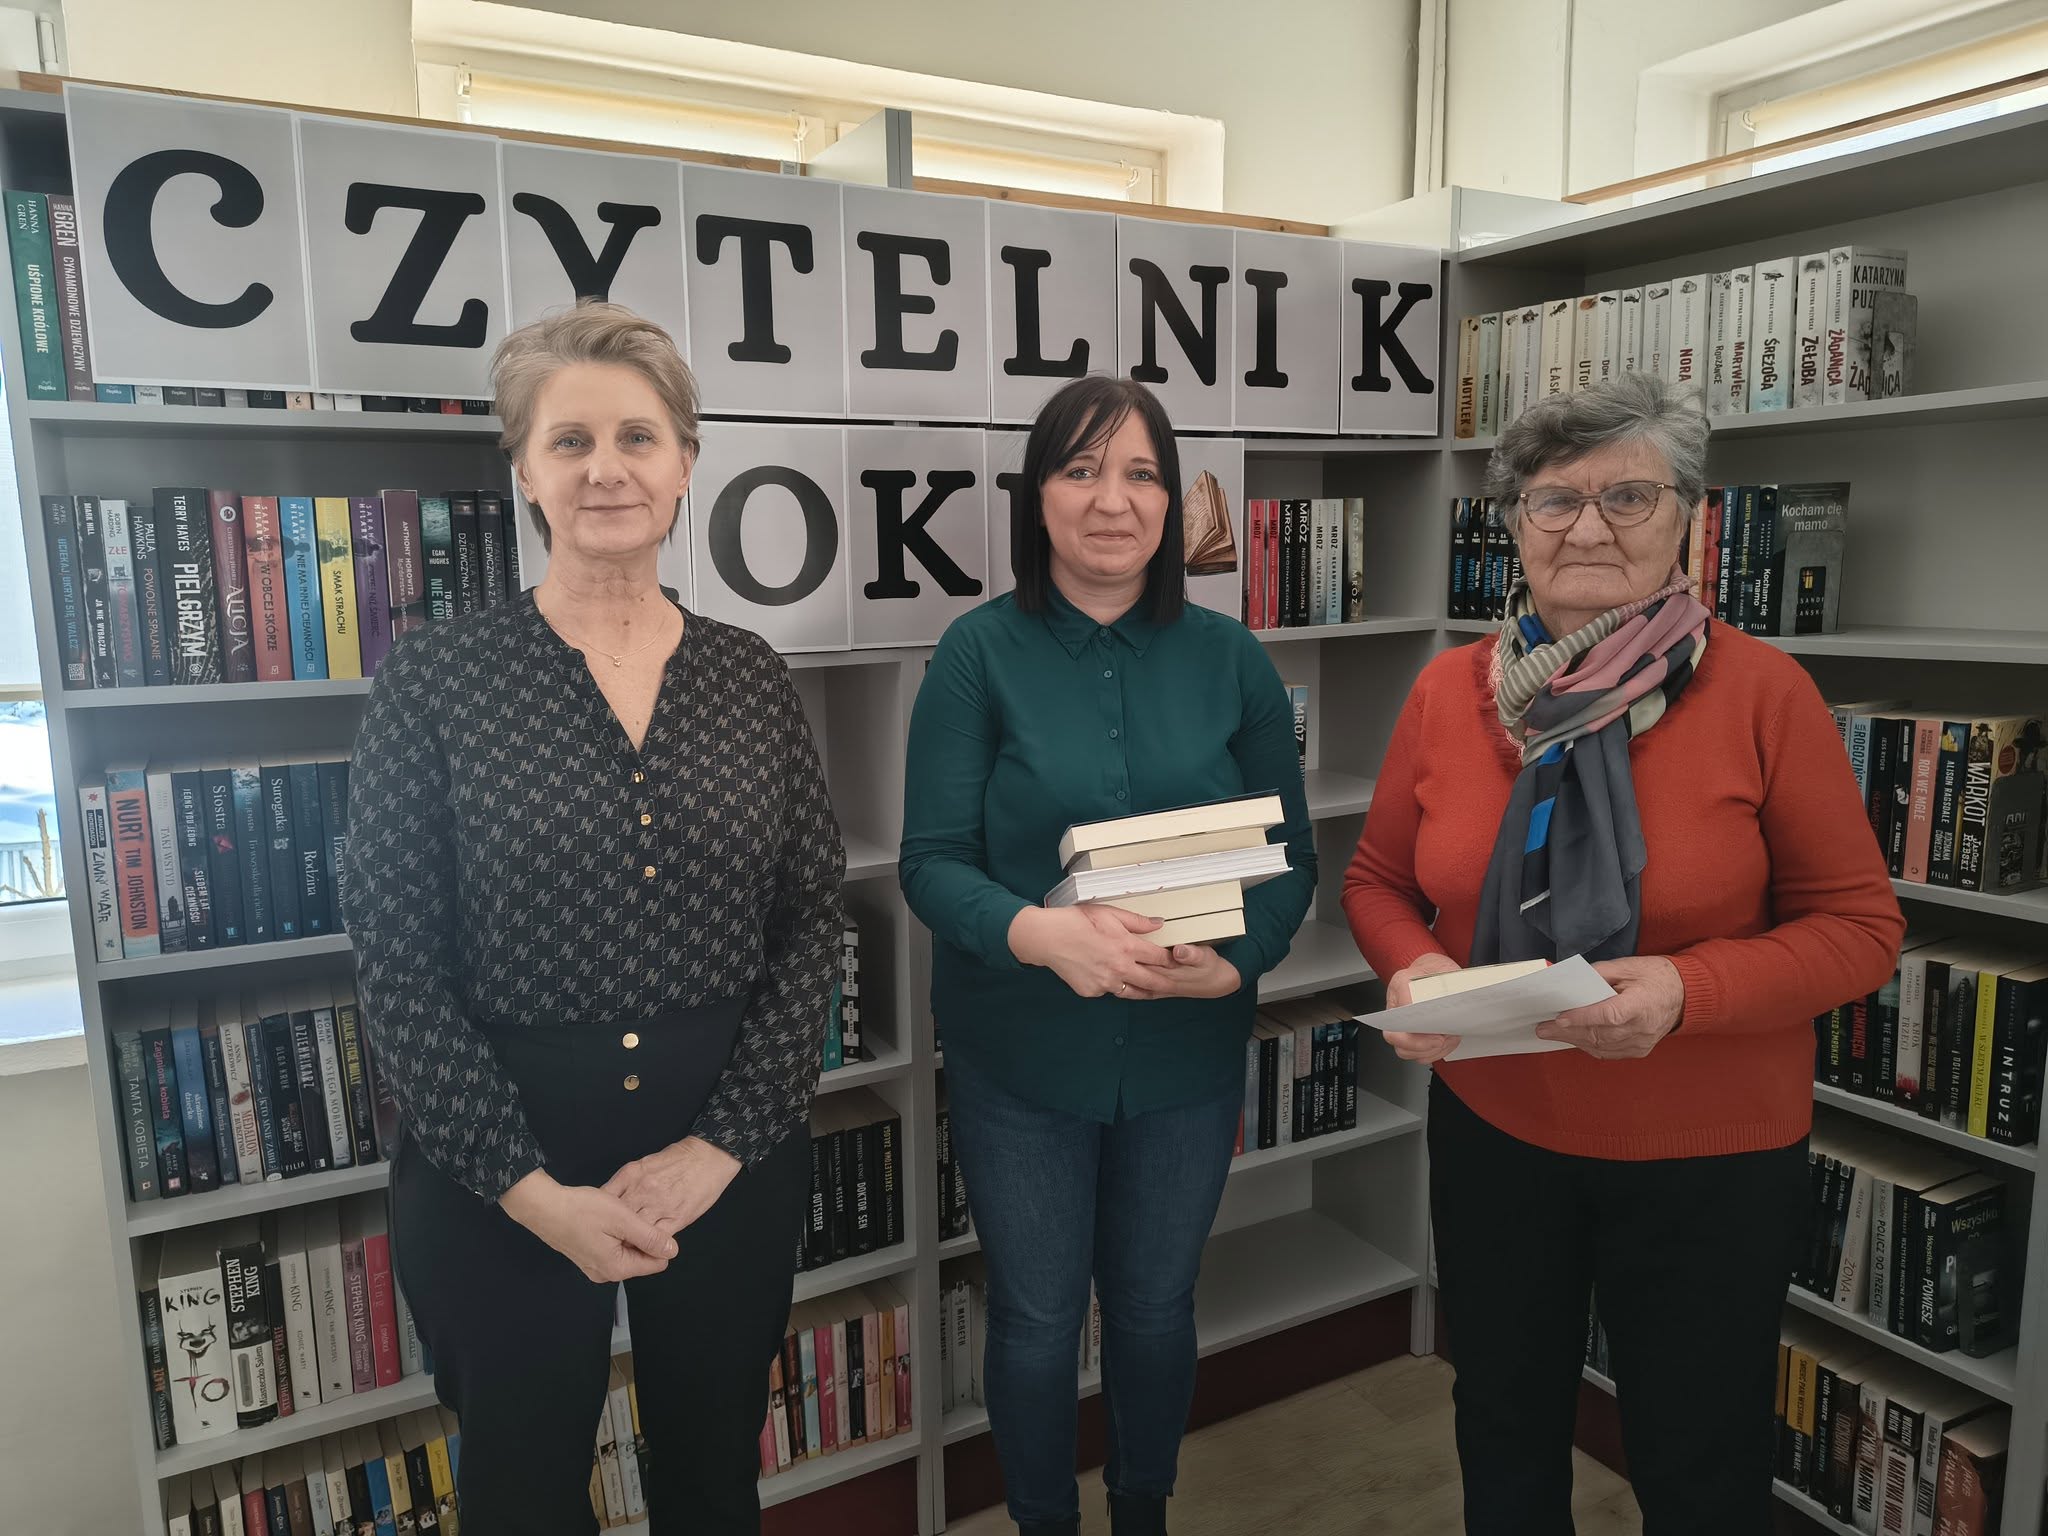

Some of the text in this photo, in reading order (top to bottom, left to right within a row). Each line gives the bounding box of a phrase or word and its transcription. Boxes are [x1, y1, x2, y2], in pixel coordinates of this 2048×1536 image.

[17, 204, 27, 230] GREŃ
[27, 200, 39, 234] HANNA
[53, 203, 73, 212] HANNA
[53, 211, 79, 247] GREŃ
[1854, 265, 1905, 287] KATARZYNA
[27, 264, 49, 354] UŚPIONE KRÓLOWE
[63, 256, 85, 371] CYNAMONOWE DZIEWCZYNY
[1679, 348, 1693, 382] NORA
[1713, 345, 1724, 384] RODZANICE
[1731, 341, 1745, 397] MARTWIEC
[1761, 338, 1780, 391] ŚREŻOGA
[1801, 336, 1819, 386] ZGŁOBA
[1828, 329, 1846, 387] ŻADANICA
[1460, 377, 1473, 425] MOTYLEK
[83, 503, 95, 535] MARK HILL
[107, 510, 115, 538] HARDING
[174, 495, 190, 551] TERRY HAYES
[254, 504, 264, 543] HILARY
[290, 504, 300, 543] HILARY
[1284, 504, 1293, 544] MRÓZ
[1299, 503, 1310, 543] MRÓZ
[1782, 504, 1824, 517] Kocham
[1794, 520, 1828, 531] mamo
[108, 546, 127, 555] ZŁE
[133, 515, 146, 560] HAWKINS
[145, 523, 156, 552] PAULA
[402, 521, 414, 596] ANTHONY HOROWITZ
[458, 533, 470, 589] DZIEWCZYNA
[484, 533, 496, 588] DZIEWCZYNA
[333, 570, 346, 635] SMAK STRACHU
[430, 578, 443, 596] NIE
[444, 591, 452, 600] TO
[1351, 570, 1360, 605] MRÓZ
[1753, 579, 1762, 606] mamo
[1760, 568, 1770, 616] Kocham cię
[95, 599, 106, 657] JA NIE WYBACZAM
[144, 568, 161, 660] POWOLNE SPALANIE
[173, 563, 207, 657] PIELGRZYM
[225, 585, 248, 656] ALICJA
[261, 578, 277, 651] OBCEJ SKÓRZE
[296, 554, 314, 662] NIE MA INNEJ CIEMNOŚCI
[1916, 759, 1930, 793] ROK WE
[1941, 760, 1955, 823] ALISON RAGSDALE
[1963, 762, 1991, 827] WARKOT
[183, 789, 197, 847] JEONG JEONG
[212, 785, 226, 830] Siostra
[271, 778, 288, 832] Surogatka
[116, 799, 148, 930] NURT TIM JOHNSTON
[163, 852, 175, 886] WSTYD
[1961, 833, 1974, 871] RYBSKI
[92, 851, 112, 923] ZIMNY WIATR
[194, 870, 209, 910] SIEDEM LAT
[303, 850, 318, 896] Rodzina
[1931, 870, 1949, 880] FILIA
[185, 886, 199, 923] CIEMNOŚCI
[1883, 1022, 1891, 1034] NIE
[224, 1028, 237, 1080] KLEJZEROWICZ
[275, 1046, 290, 1090] OLGA KRUK
[295, 1024, 315, 1089] DZIENNIKARZ
[1831, 1031, 1841, 1066] ZMROKIEM
[153, 1040, 170, 1120] Zaginiona kobieta
[325, 1057, 336, 1096] WSTĘGA
[1876, 1086, 1894, 1096] FILIA
[1998, 1046, 2014, 1123] INTRUZ
[128, 1076, 149, 1169] TAMTA KOBIETA
[184, 1092, 194, 1119] dziecko
[235, 1118, 246, 1157] BURSZTYNEM
[242, 1110, 255, 1156] MEDALION
[1992, 1127, 2012, 1138] FILIA
[812, 1193, 823, 1232] OUTSIDER
[857, 1182, 867, 1229] DOKTOR SEN
[244, 1266, 260, 1298] KING
[1840, 1258, 1857, 1293] ŻONA
[1873, 1219, 1886, 1308] POLICZ DO TRZECH
[165, 1288, 220, 1313] KING
[226, 1258, 245, 1313] STEPHEN
[290, 1285, 302, 1312] KING
[323, 1290, 335, 1316] KING
[350, 1275, 364, 1317] STEPHEN
[1921, 1278, 1933, 1325] POWIESZ
[354, 1317, 366, 1342] KING
[957, 1308, 966, 1346] MACBETH
[173, 1373, 229, 1414] TO
[255, 1345, 268, 1407] Miasteczko Salem
[278, 1354, 290, 1411] STEPHEN KING
[1797, 1382, 1807, 1396] PANI
[1822, 1375, 1830, 1395] ruth
[1793, 1433, 1802, 1472] RUTH WARE
[1833, 1413, 1852, 1468] LOCKDOWN
[1861, 1425, 1877, 1458] ŻYWA
[1856, 1465, 1873, 1513] MARTWA
[1883, 1457, 1906, 1533] MARTWA WODA
